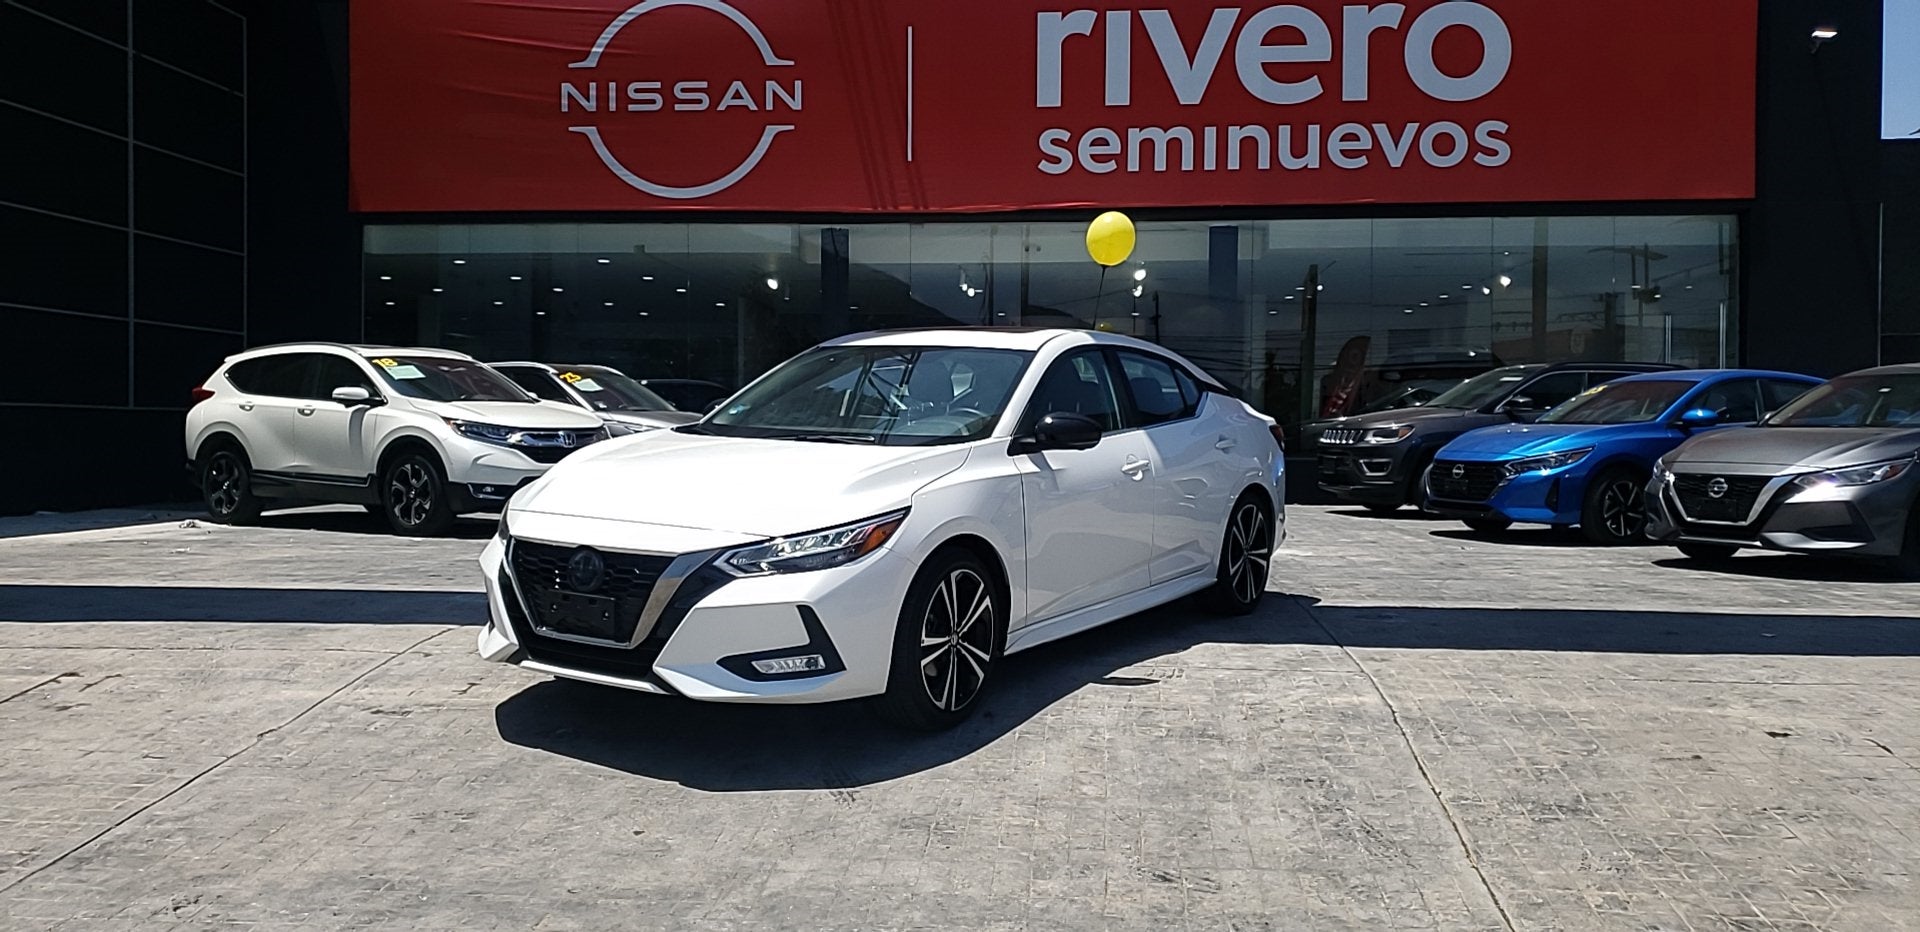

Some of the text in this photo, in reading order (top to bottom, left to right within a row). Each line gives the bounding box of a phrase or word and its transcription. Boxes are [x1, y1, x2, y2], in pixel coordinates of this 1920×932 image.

[1037, 2, 1513, 109] rivero
[561, 80, 803, 114] NISSAN
[1038, 120, 1513, 176] seminuevos
